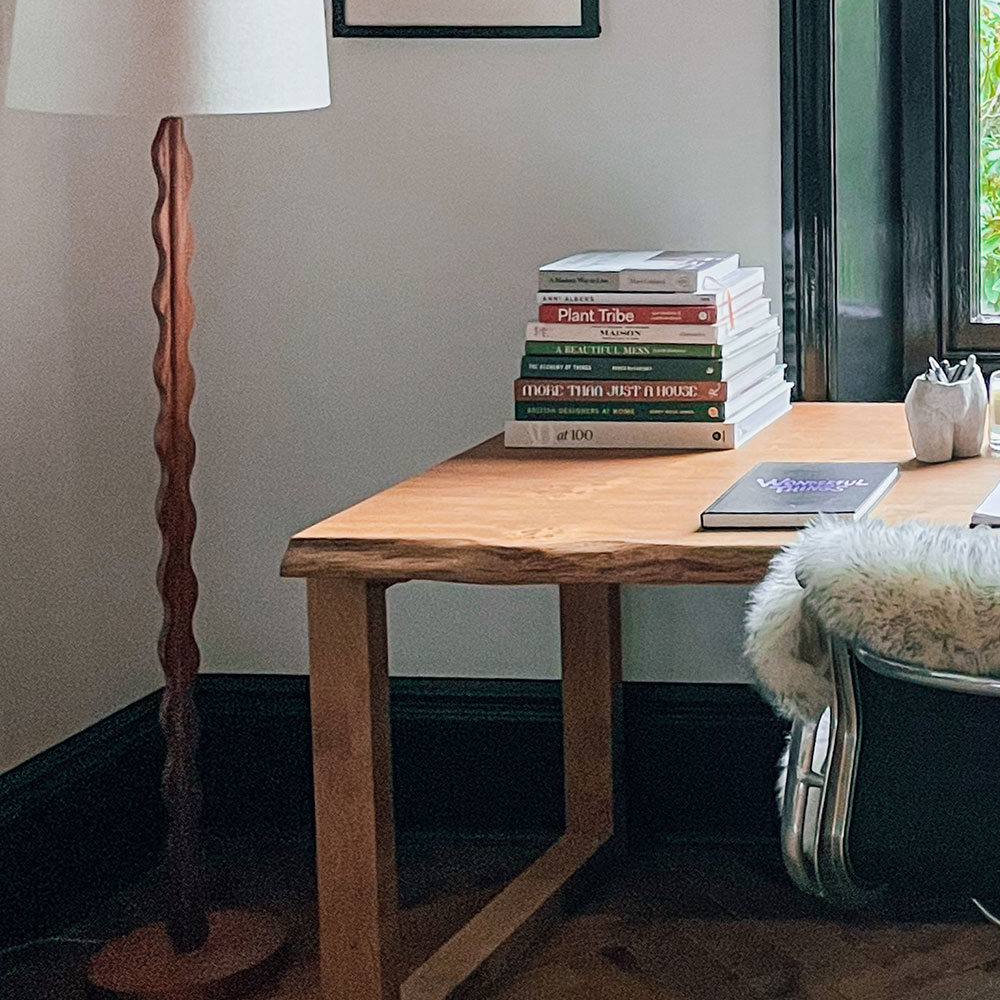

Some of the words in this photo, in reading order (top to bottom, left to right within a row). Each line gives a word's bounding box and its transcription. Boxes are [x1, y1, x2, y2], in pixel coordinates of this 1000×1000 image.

[558, 308, 595, 322] Plant
[598, 308, 635, 323] Tribe
[600, 329, 641, 337] MAISON
[555, 346, 562, 354] A
[564, 345, 620, 355] BEAUTIFUL
[522, 384, 564, 397] MORE
[567, 384, 604, 397] THAN
[606, 384, 641, 397] JUST
[643, 385, 654, 397] A
[656, 385, 698, 397] HOUSE
[556, 430, 568, 442] at
[571, 429, 594, 441] 100
